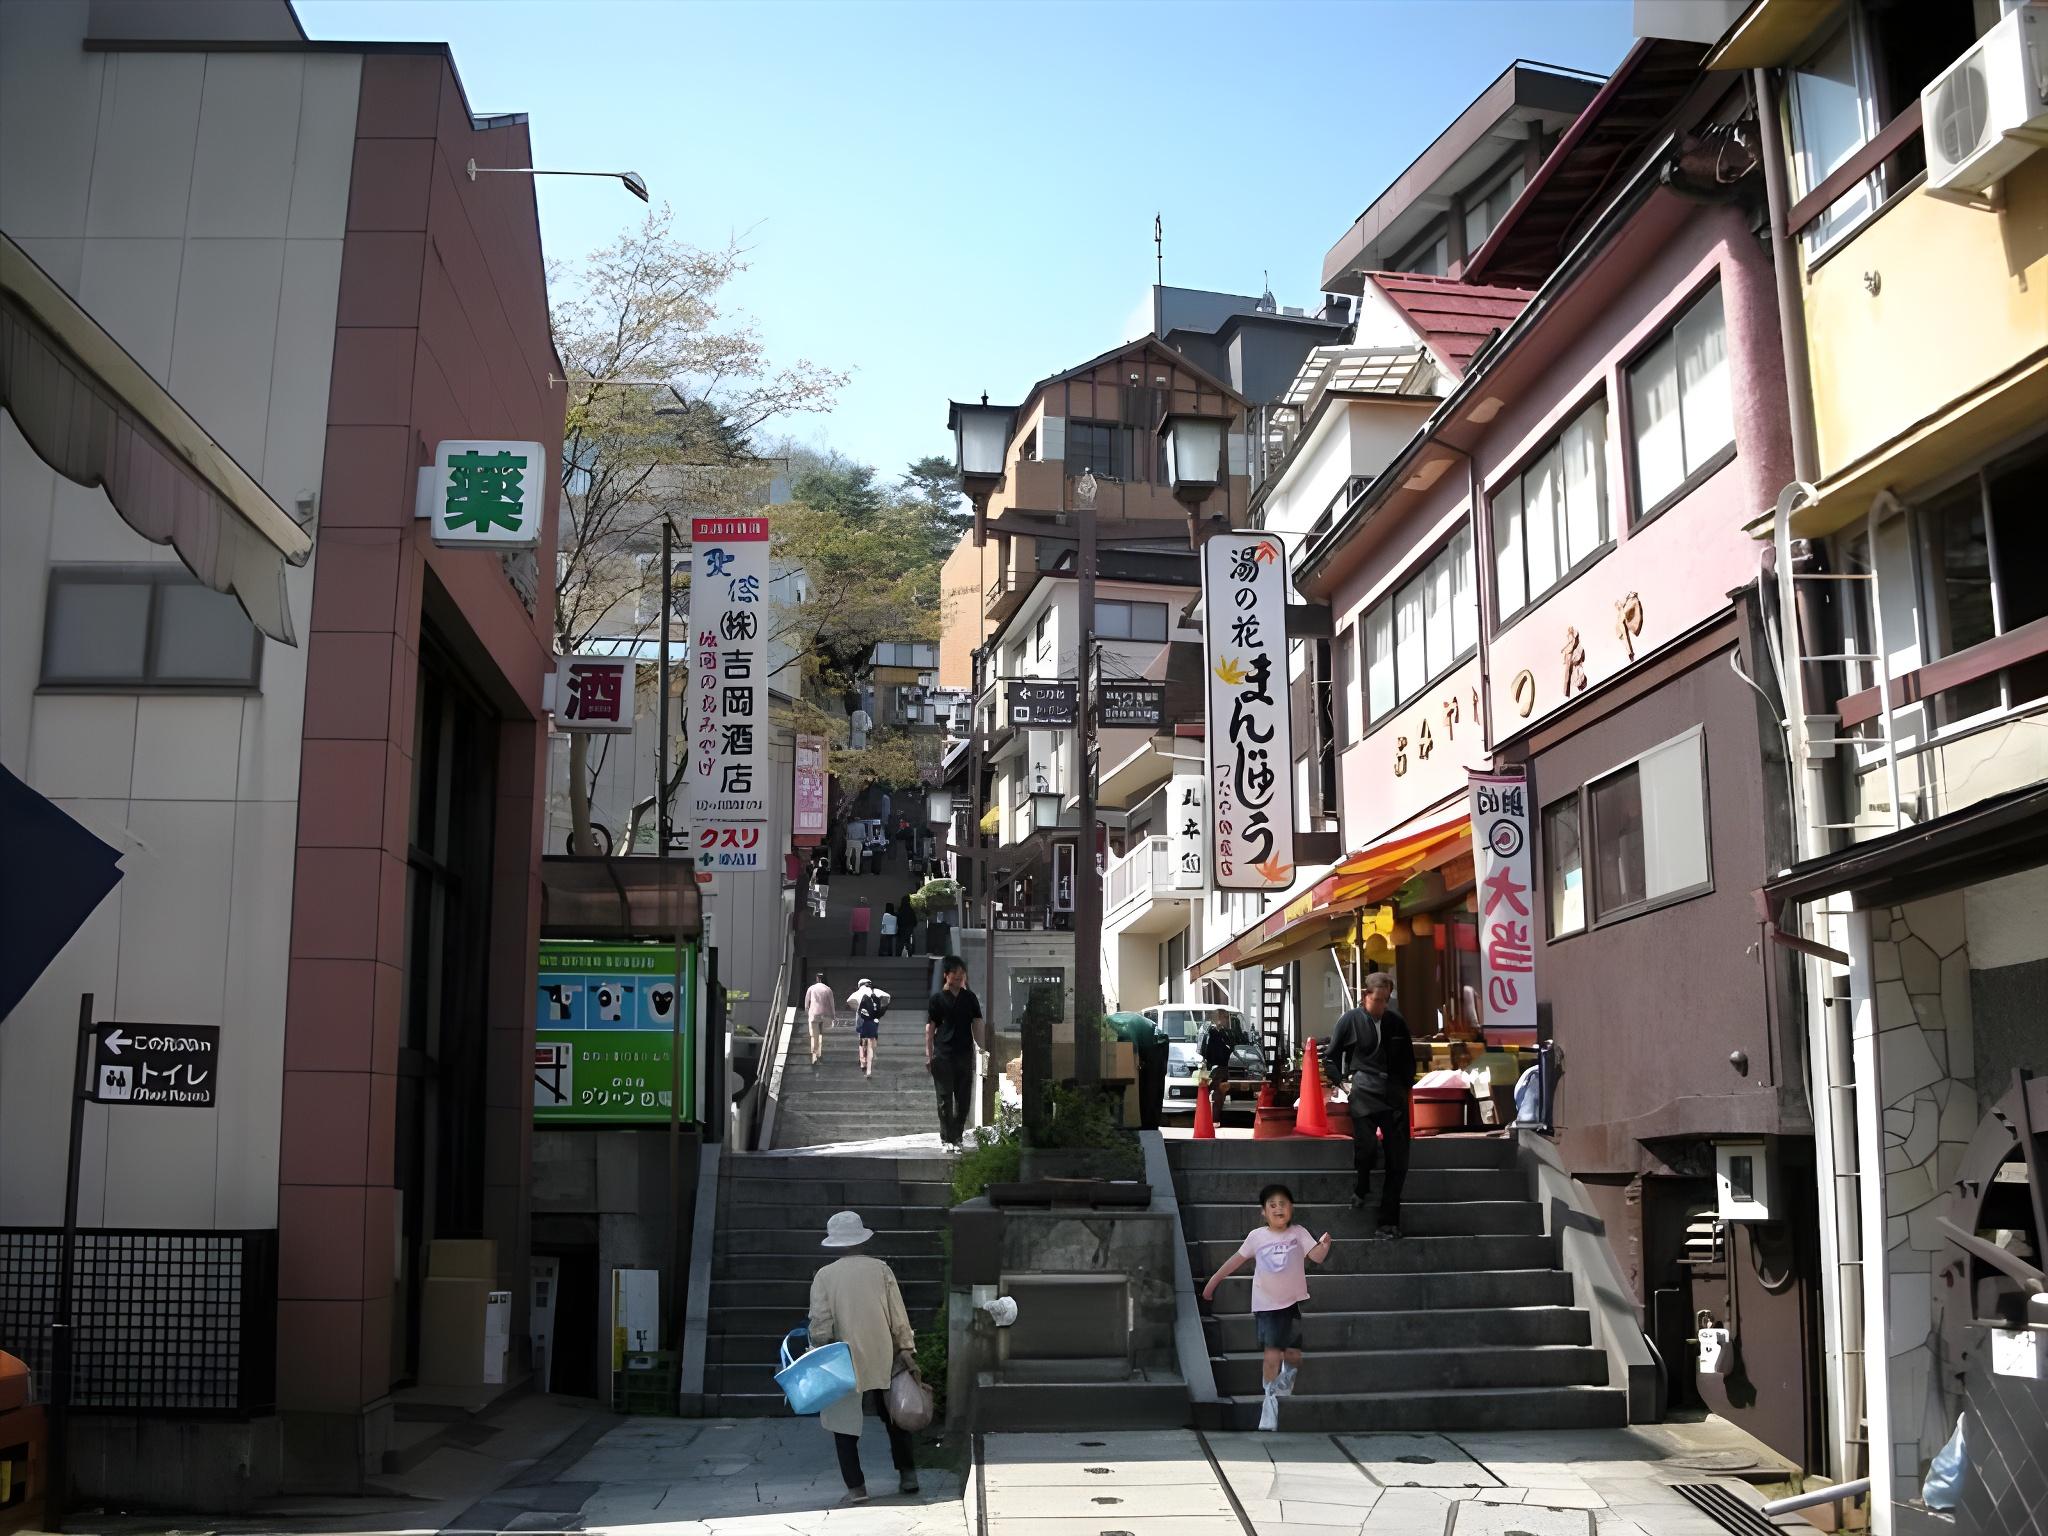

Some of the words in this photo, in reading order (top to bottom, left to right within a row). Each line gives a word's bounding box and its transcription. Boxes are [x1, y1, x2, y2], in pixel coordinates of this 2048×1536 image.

[445, 450, 528, 533] 薬
[564, 663, 625, 721] 酒
[700, 827, 760, 849] クスリ
[141, 1061, 209, 1086] トイレ
